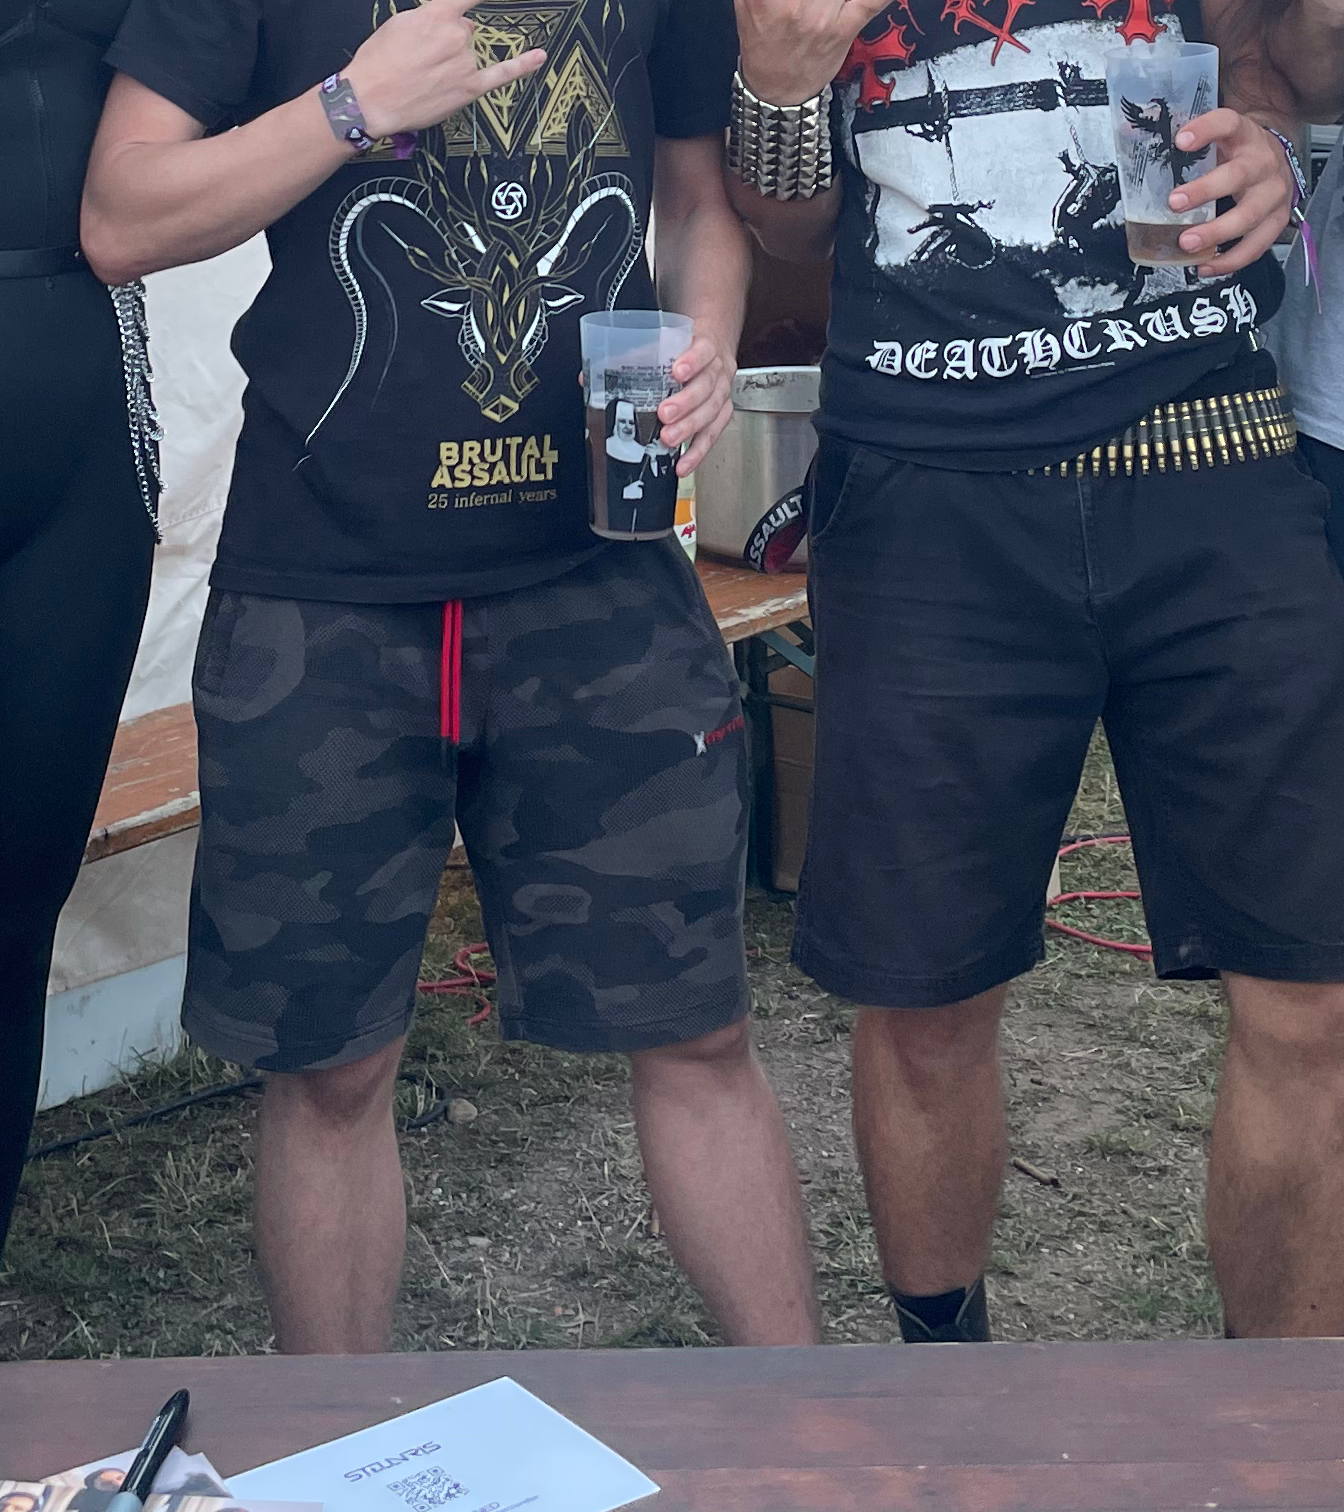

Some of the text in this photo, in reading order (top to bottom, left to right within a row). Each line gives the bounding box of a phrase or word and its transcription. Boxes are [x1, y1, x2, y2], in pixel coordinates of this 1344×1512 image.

[865, 284, 1259, 380] DEATHCRUSH
[440, 434, 558, 467] BRUTAL
[431, 457, 558, 488] ASSAULT
[427, 489, 556, 508] 25 infernal years
